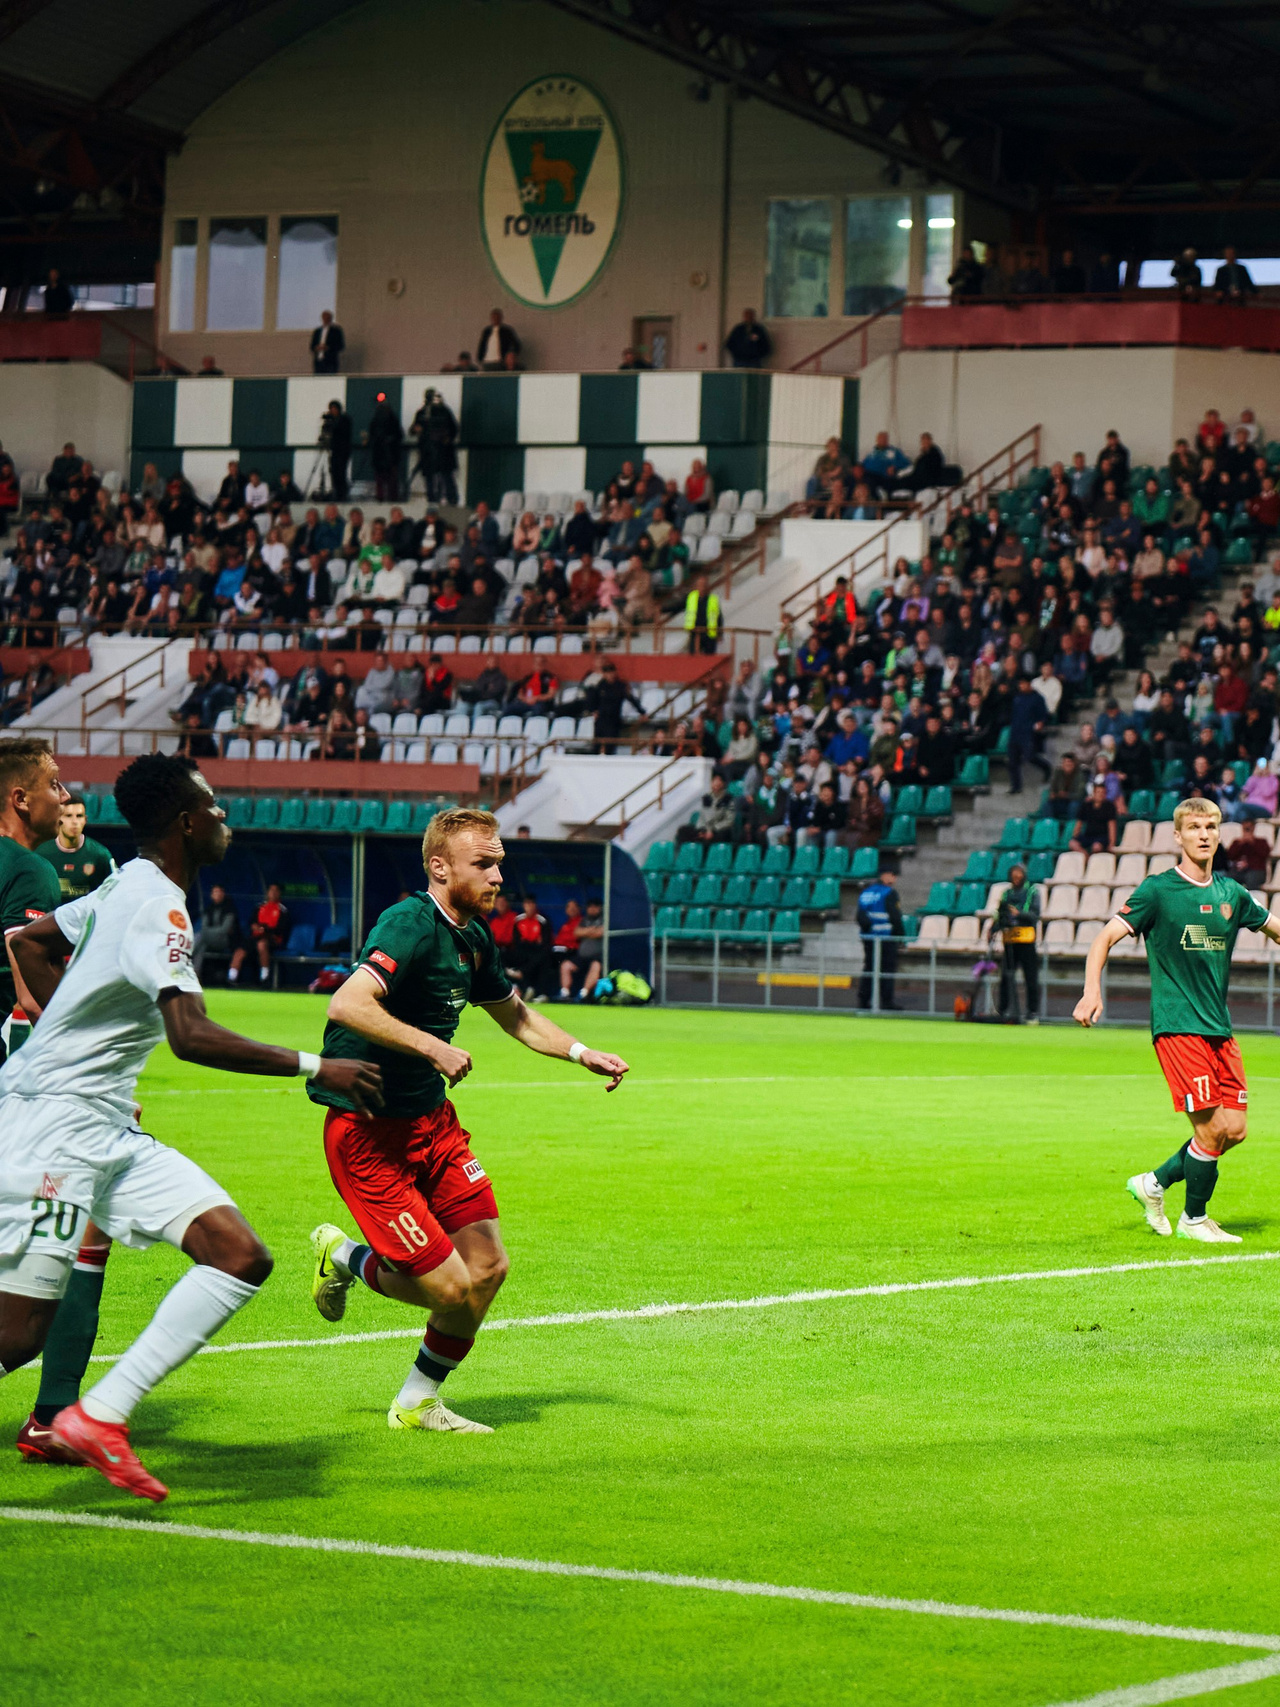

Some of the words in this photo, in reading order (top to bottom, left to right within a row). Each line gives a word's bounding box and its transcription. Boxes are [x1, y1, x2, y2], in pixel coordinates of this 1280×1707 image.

[504, 212, 596, 238] ГОМЕЛЬ
[1193, 1074, 1210, 1102] 77
[31, 1197, 79, 1241] 20
[388, 1211, 428, 1254] 18
